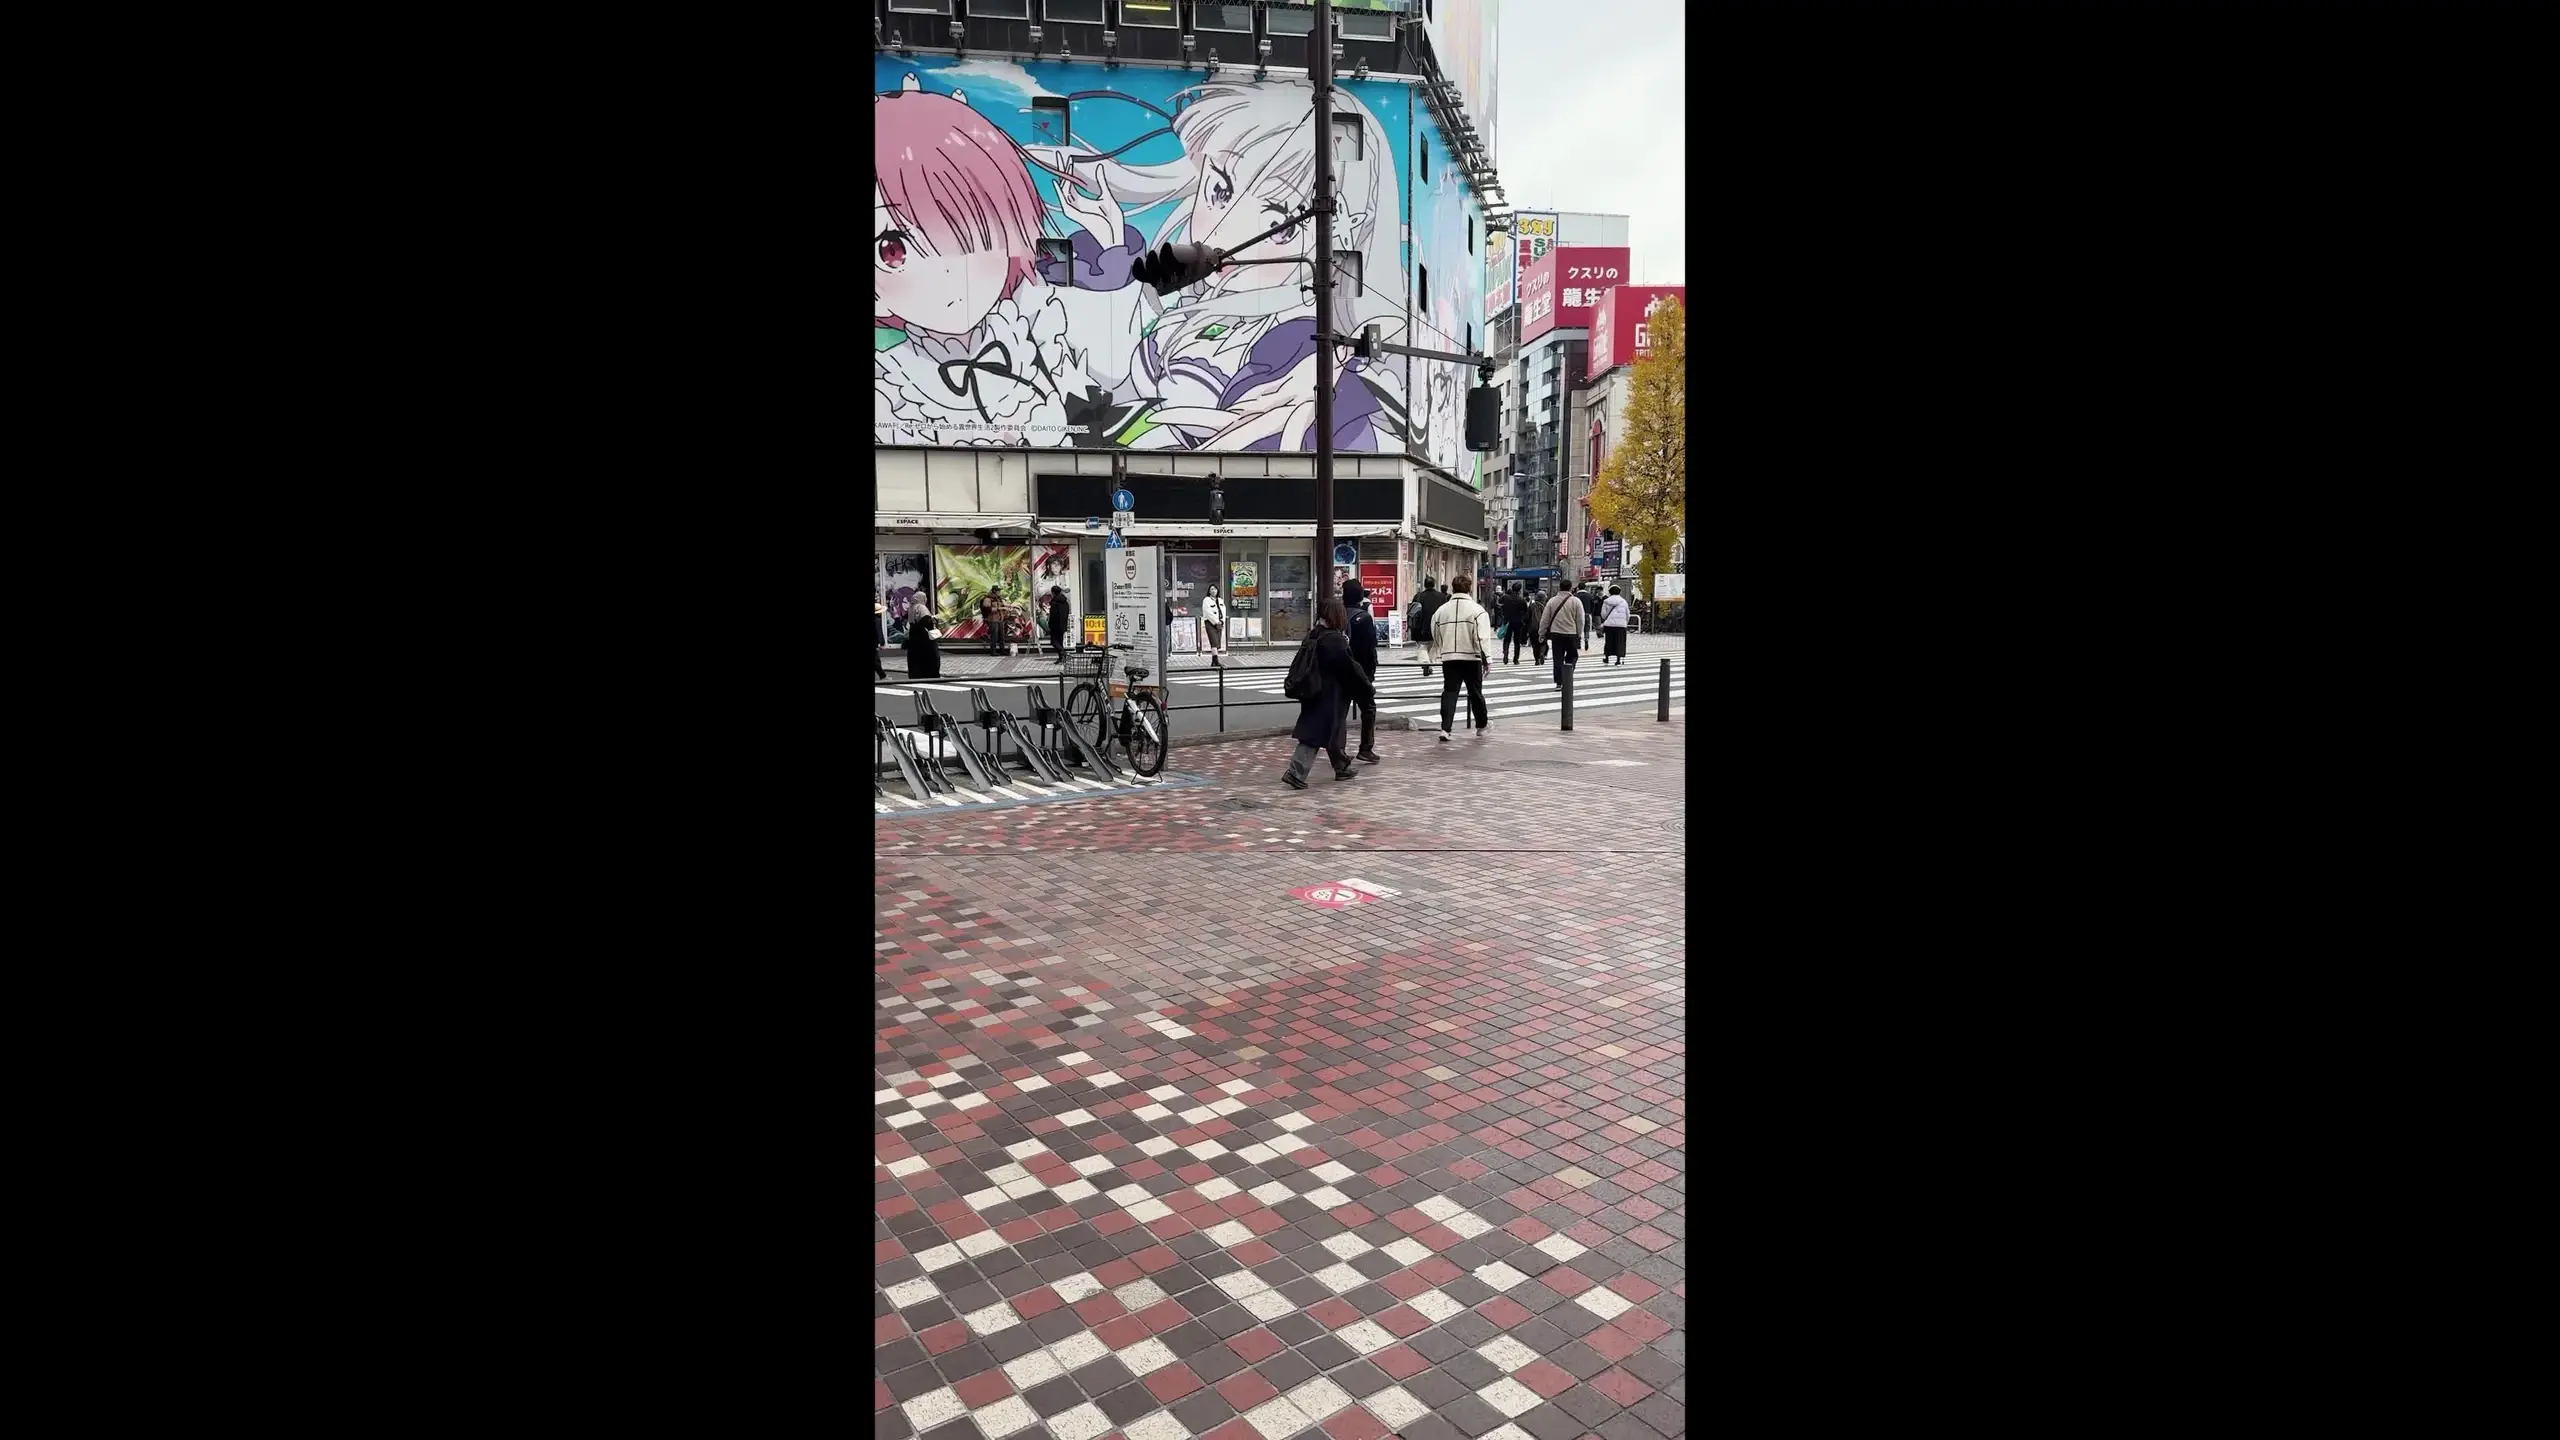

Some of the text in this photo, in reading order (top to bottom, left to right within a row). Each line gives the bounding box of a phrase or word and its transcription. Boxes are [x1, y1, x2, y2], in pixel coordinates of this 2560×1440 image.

[1567, 266, 1619, 280] クスリの
[1562, 287, 1611, 308] 龍生
[1595, 538, 1602, 550] P
